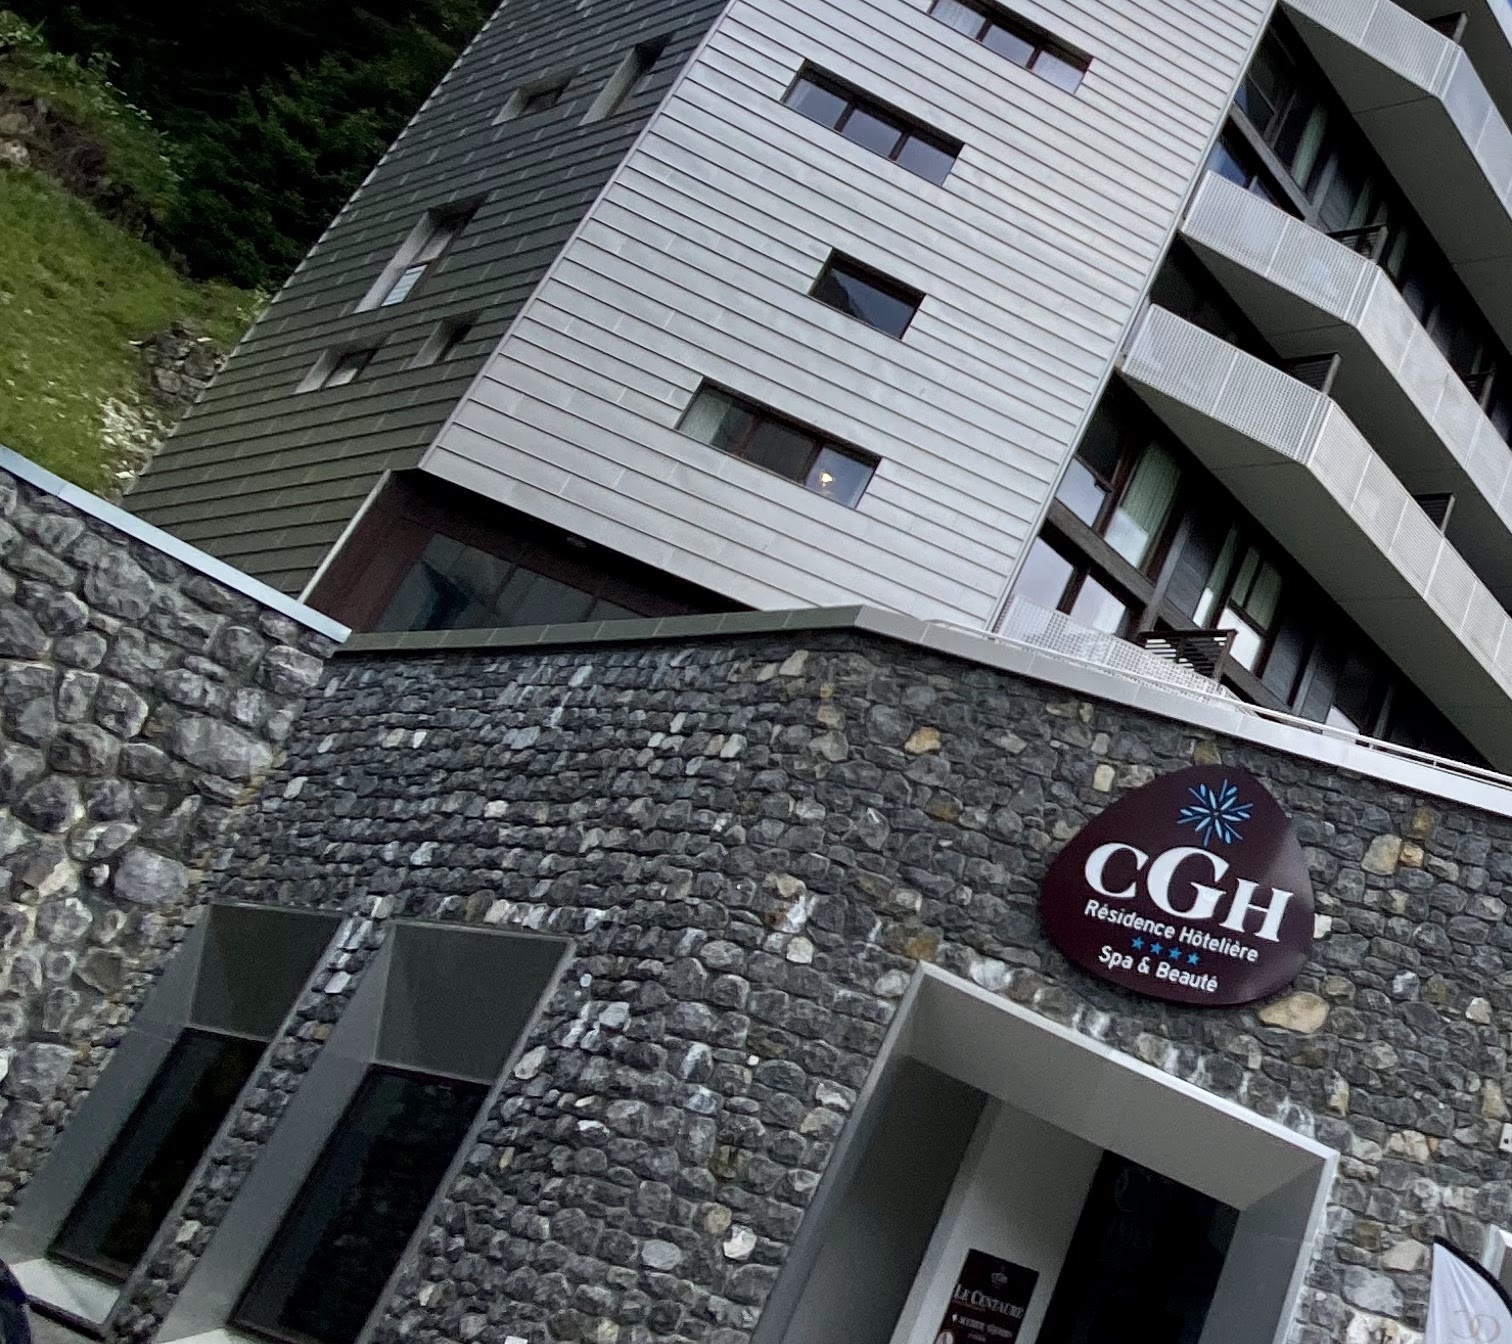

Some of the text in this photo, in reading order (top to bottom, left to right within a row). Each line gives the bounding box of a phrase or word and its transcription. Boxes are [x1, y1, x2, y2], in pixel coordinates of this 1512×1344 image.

[1085, 843, 1294, 943] CGH
[1085, 899, 1259, 962] Résidence Hôtelière
[1099, 945, 1218, 992] Spa & Beauté
